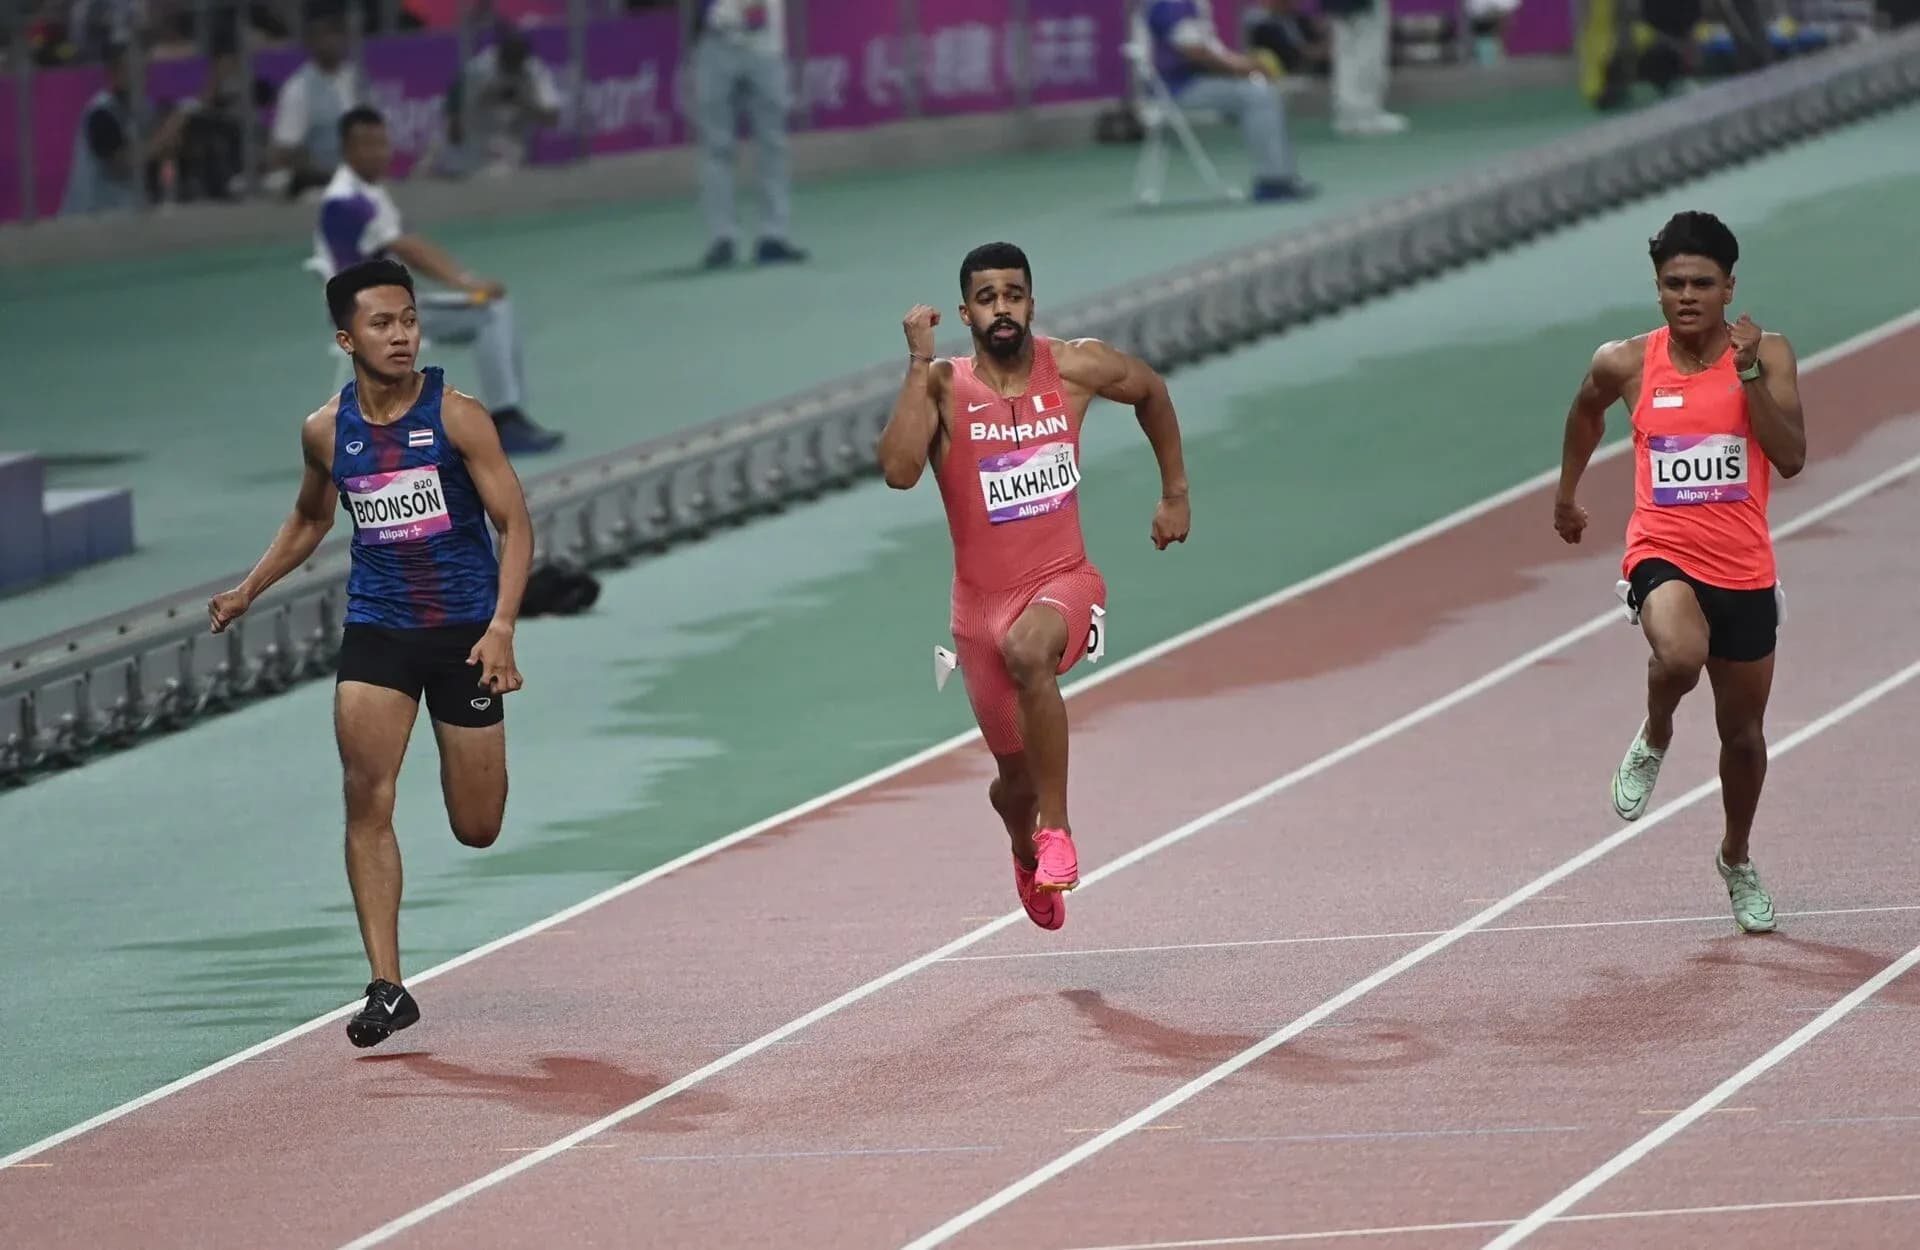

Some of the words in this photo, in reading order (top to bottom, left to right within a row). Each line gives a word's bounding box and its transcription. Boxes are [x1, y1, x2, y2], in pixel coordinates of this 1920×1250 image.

[970, 415, 1068, 442] BAHRAIN
[1723, 445, 1741, 454] 760
[1055, 451, 1069, 463] 137
[1657, 456, 1741, 482] LOUIS
[413, 478, 433, 490] 820
[989, 461, 1077, 504] ALKHALDI
[1676, 489, 1710, 501] Alipay
[354, 488, 442, 523] BOONSON
[1018, 502, 1050, 517] Alipay
[379, 528, 409, 541] Alipay
